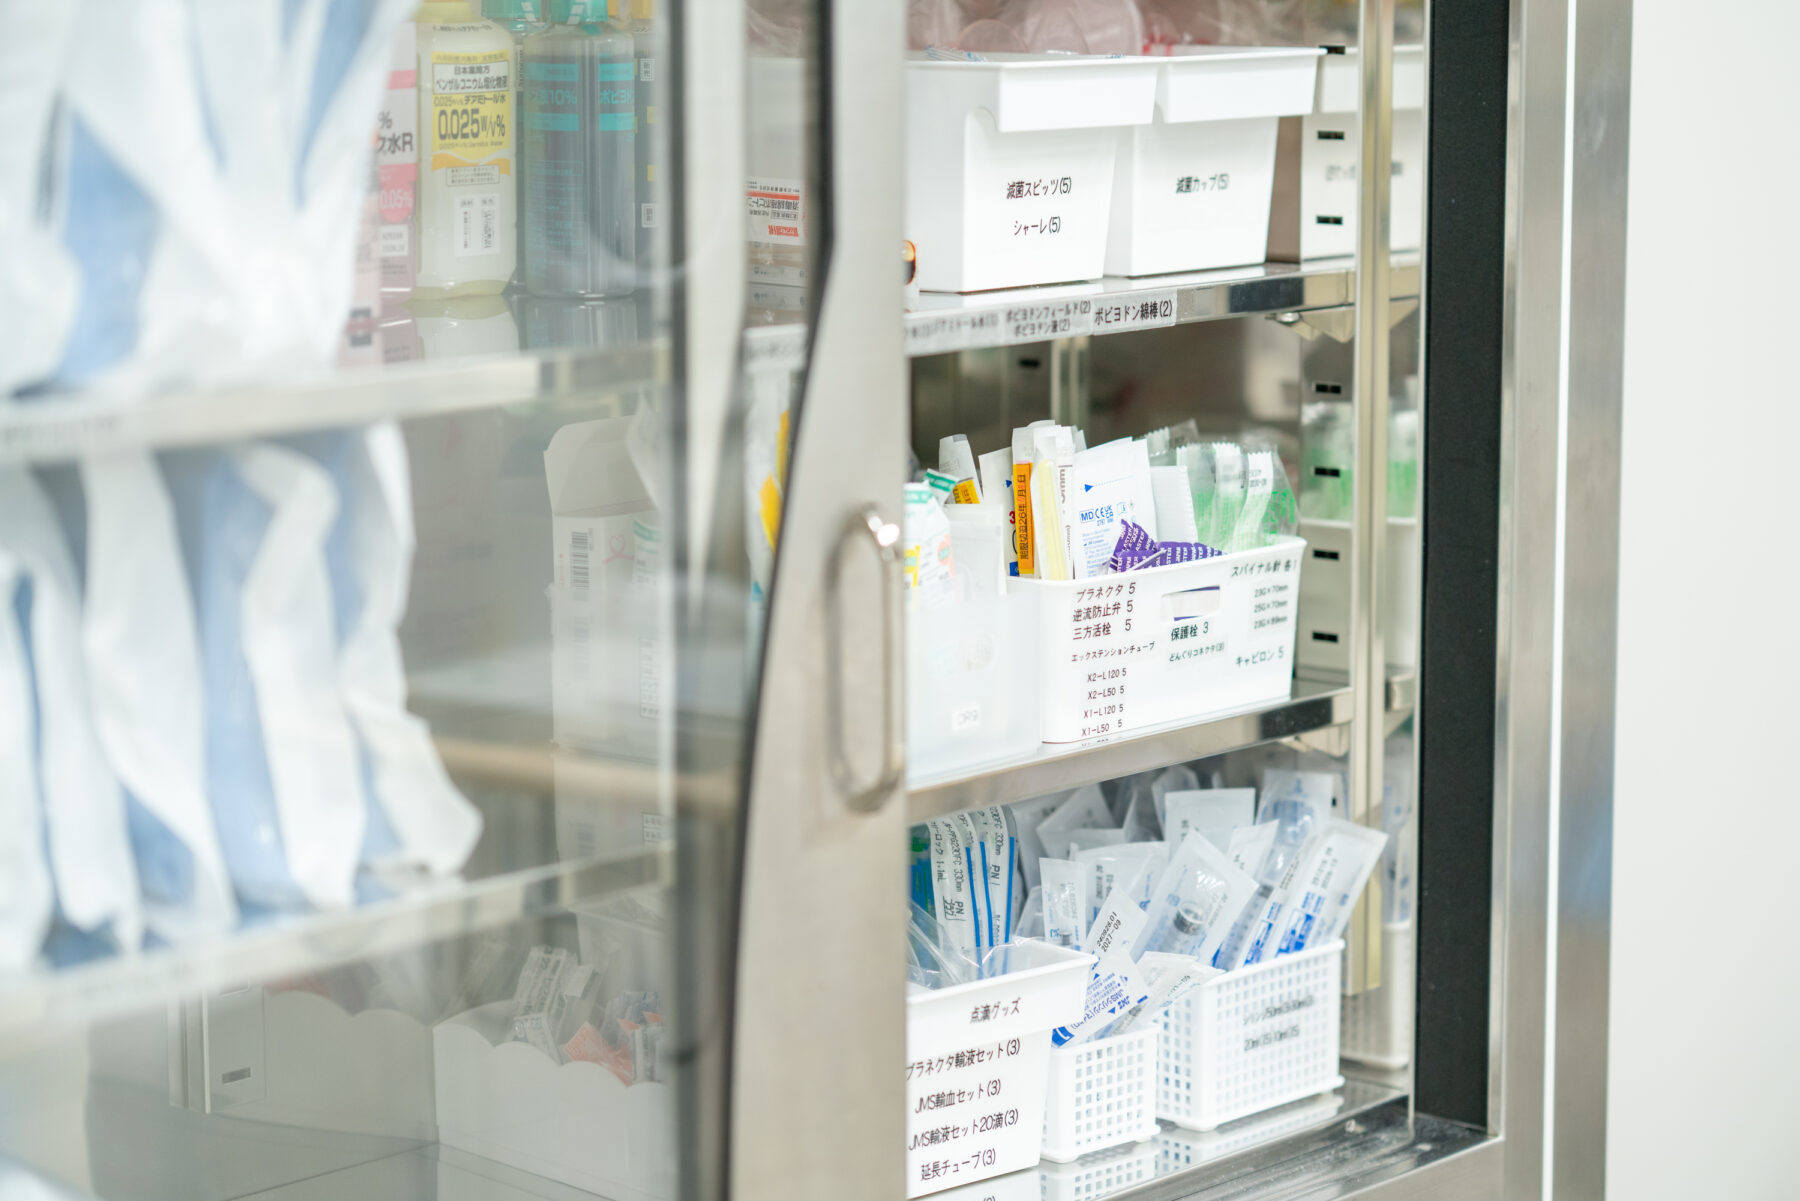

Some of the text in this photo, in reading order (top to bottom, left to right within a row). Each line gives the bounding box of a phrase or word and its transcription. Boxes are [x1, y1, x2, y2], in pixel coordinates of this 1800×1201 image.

[1006, 176, 1072, 199] 滅菌スピッツ(5)
[1176, 173, 1229, 194] 滅菌カップ(5)
[1013, 216, 1061, 236] シャーレ(5)
[1093, 299, 1173, 326] ポビヨドン綿棒(2)
[1080, 511, 1094, 522] MD
[1076, 581, 1137, 603] プラネクタ 5
[1073, 599, 1134, 622] 逆流防止弁 5
[1072, 618, 1132, 640] 三方活栓 5
[1170, 620, 1209, 642] 保護栓 3
[1278, 645, 1284, 659] 5
[1087, 667, 1127, 683] X2-L120 5
[1087, 685, 1125, 700] X2-L50 5
[1083, 703, 1124, 719] X1-L120 5
[1081, 718, 1123, 737] X1-L50 5
[970, 997, 1022, 1024] 点滴グッズ
[906, 1037, 1021, 1081] プラネクタ輸液セット(3)
[915, 1078, 1002, 1114] JMS輸血セット(3)
[908, 1108, 1019, 1151] JMS輸液セット20滴(3)
[920, 1147, 997, 1182] 延長チューブ(3)
